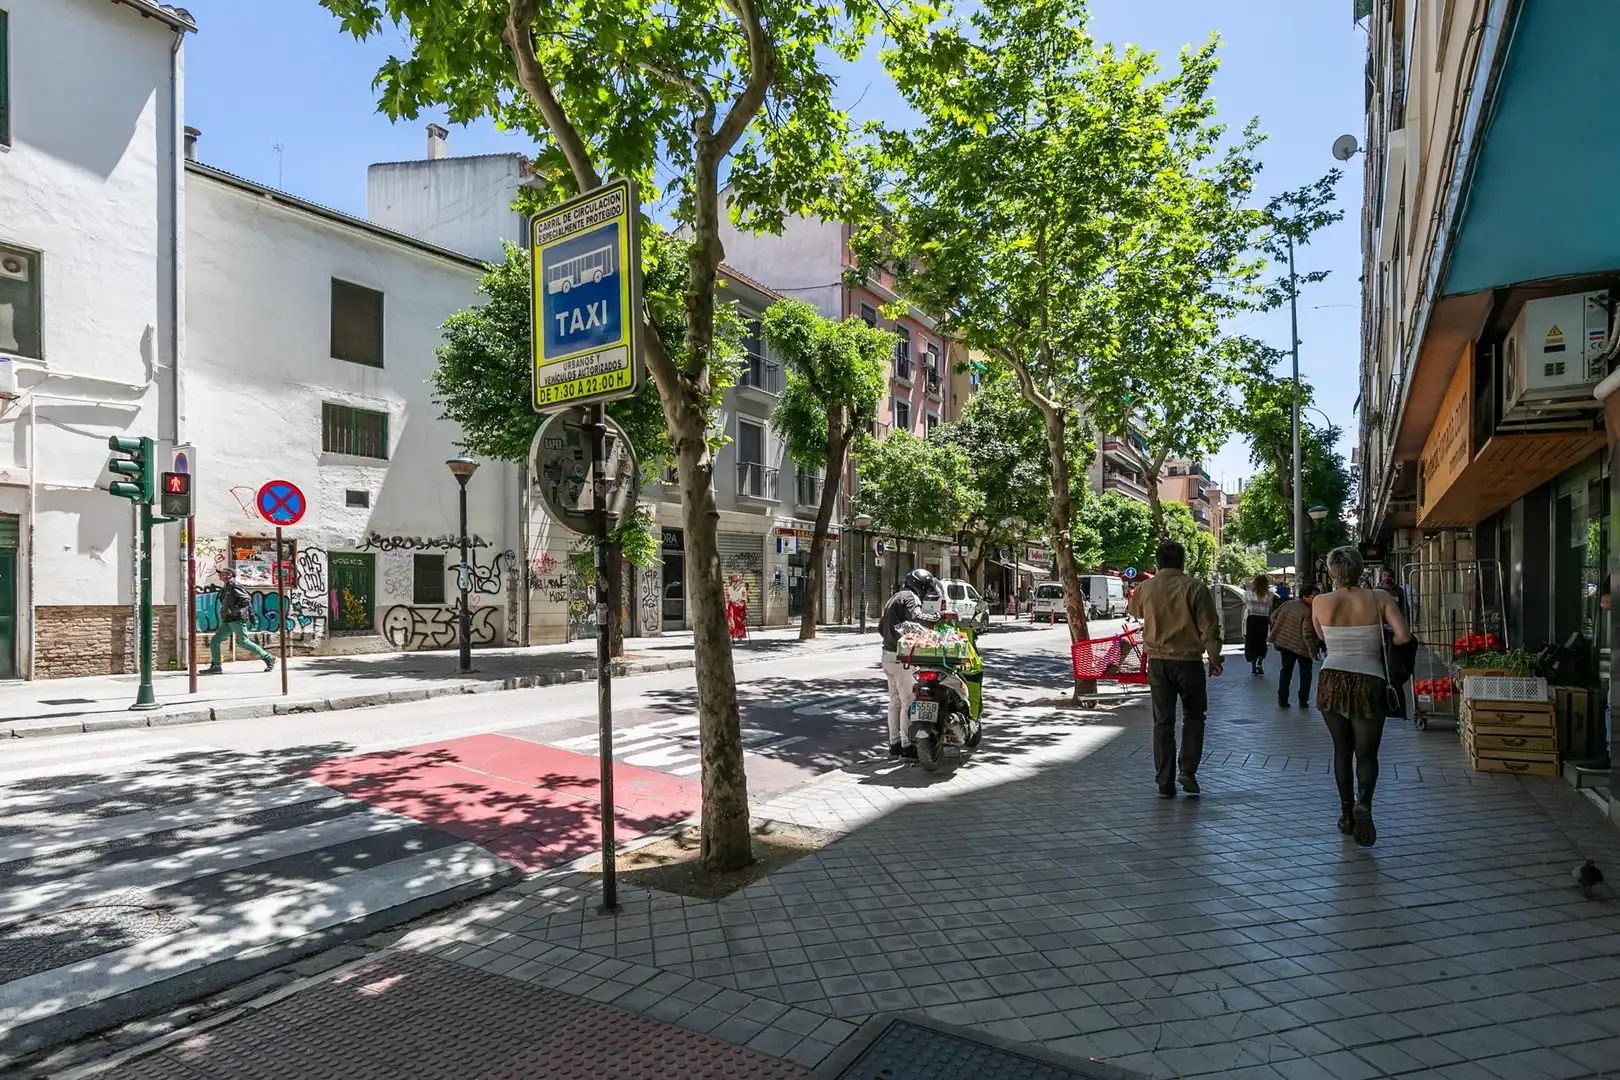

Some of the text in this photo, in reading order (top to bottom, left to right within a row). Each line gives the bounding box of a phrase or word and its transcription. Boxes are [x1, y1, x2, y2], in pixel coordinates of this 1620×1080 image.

[538, 218, 561, 233] CARRIL
[563, 213, 571, 224] DE
[538, 205, 621, 244] ESPECIALMENTE PROTEGIDO
[555, 299, 608, 337] TAXI
[563, 355, 594, 371] URBANOS
[578, 359, 622, 377] AUTORIZADOS
[540, 388, 551, 402] DE
[554, 384, 575, 400] 7:30
[577, 381, 584, 395] A
[586, 375, 614, 393] 22:00
[917, 702, 937, 712] 5559
